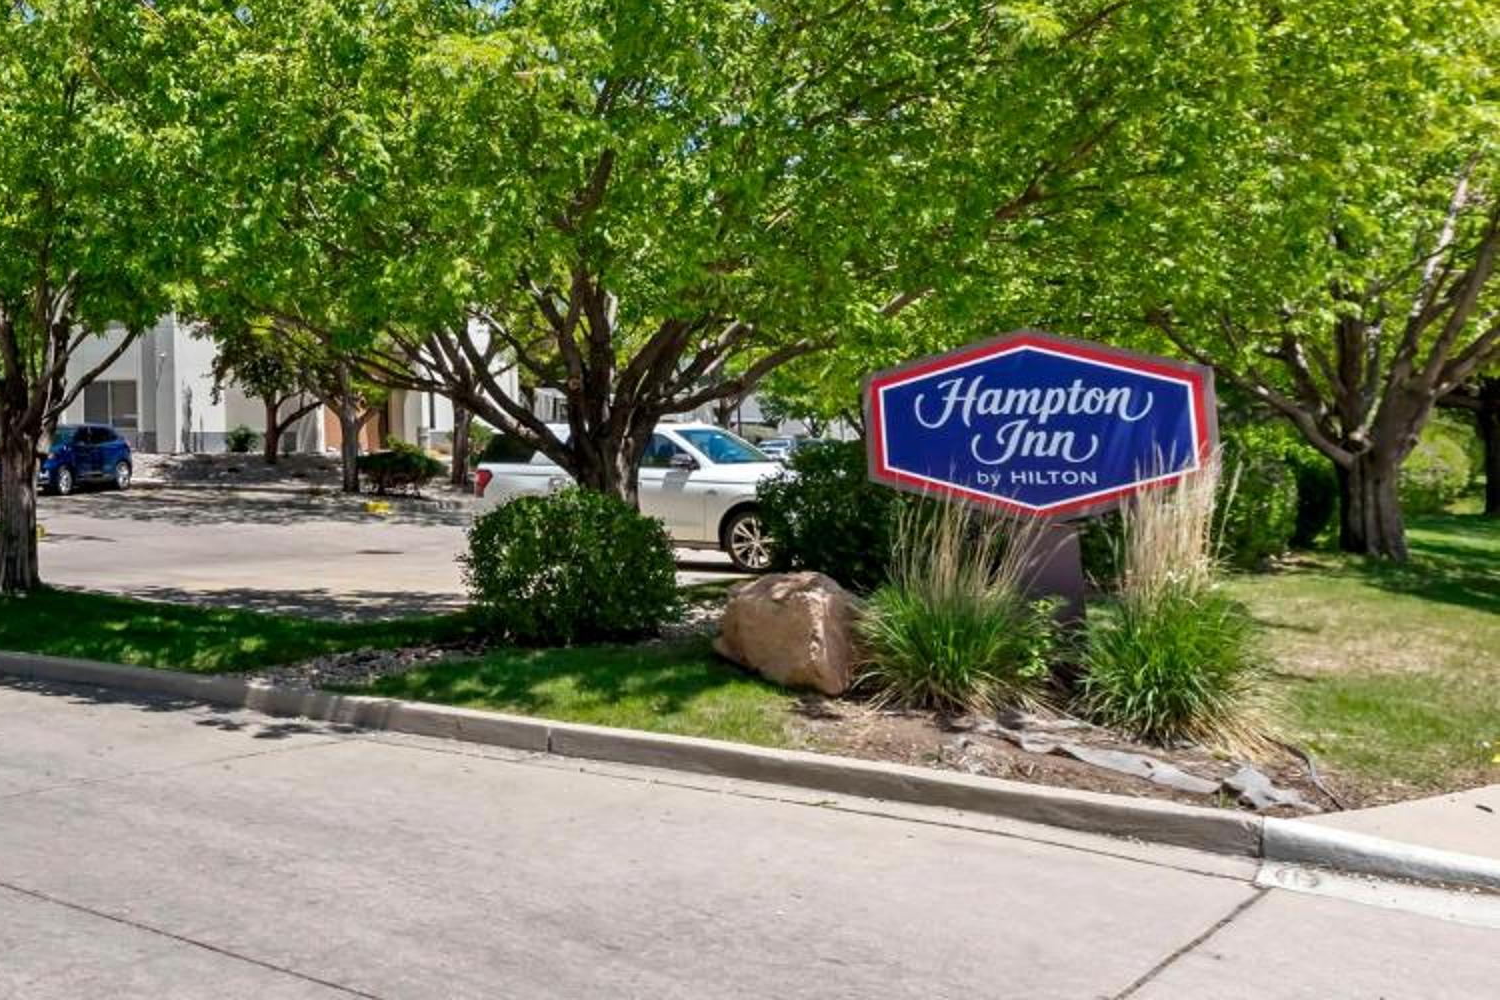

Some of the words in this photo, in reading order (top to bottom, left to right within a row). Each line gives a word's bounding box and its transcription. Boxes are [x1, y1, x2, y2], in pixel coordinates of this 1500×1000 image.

[915, 375, 1153, 428] Hampton
[972, 420, 1098, 465] Inn
[977, 470, 1001, 487] by
[1011, 471, 1098, 485] HILTON
